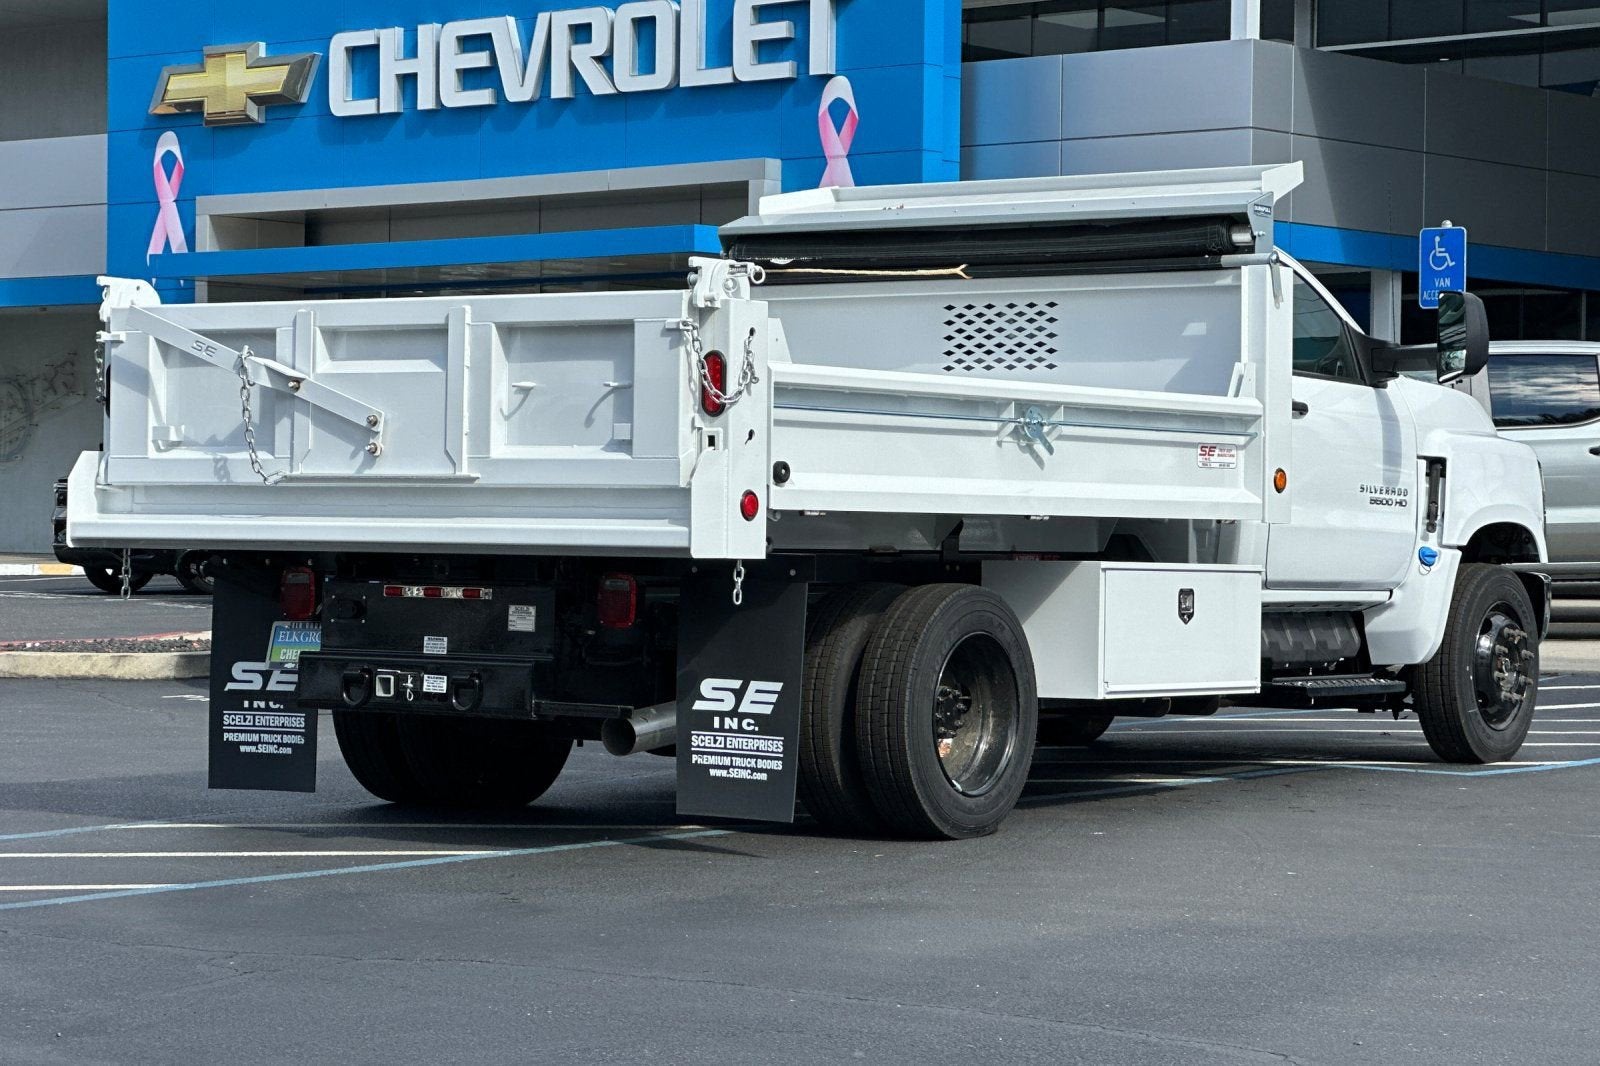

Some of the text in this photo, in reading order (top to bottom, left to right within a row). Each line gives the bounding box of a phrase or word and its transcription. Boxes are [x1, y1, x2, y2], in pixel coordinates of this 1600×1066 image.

[329, 0, 836, 117] CHEVROLET
[1434, 277, 1451, 288] VAN
[191, 340, 217, 357] SE
[1199, 445, 1217, 457] SE
[1360, 484, 1409, 497] SILVERADO
[1395, 498, 1408, 507] HD
[224, 661, 299, 692] SE
[692, 678, 784, 714] SE
[223, 714, 305, 728] SCELZI ENTERPRISES
[713, 716, 759, 731] INC.
[223, 732, 305, 745] PREMIUM TRUCK BODIES
[691, 735, 784, 753] SCELZI ENTERPRISES
[239, 744, 292, 755] www.SEINC.com
[691, 754, 783, 771] PREMIUM TRUCK BODIES
[709, 768, 768, 781] www.SEINC.com
